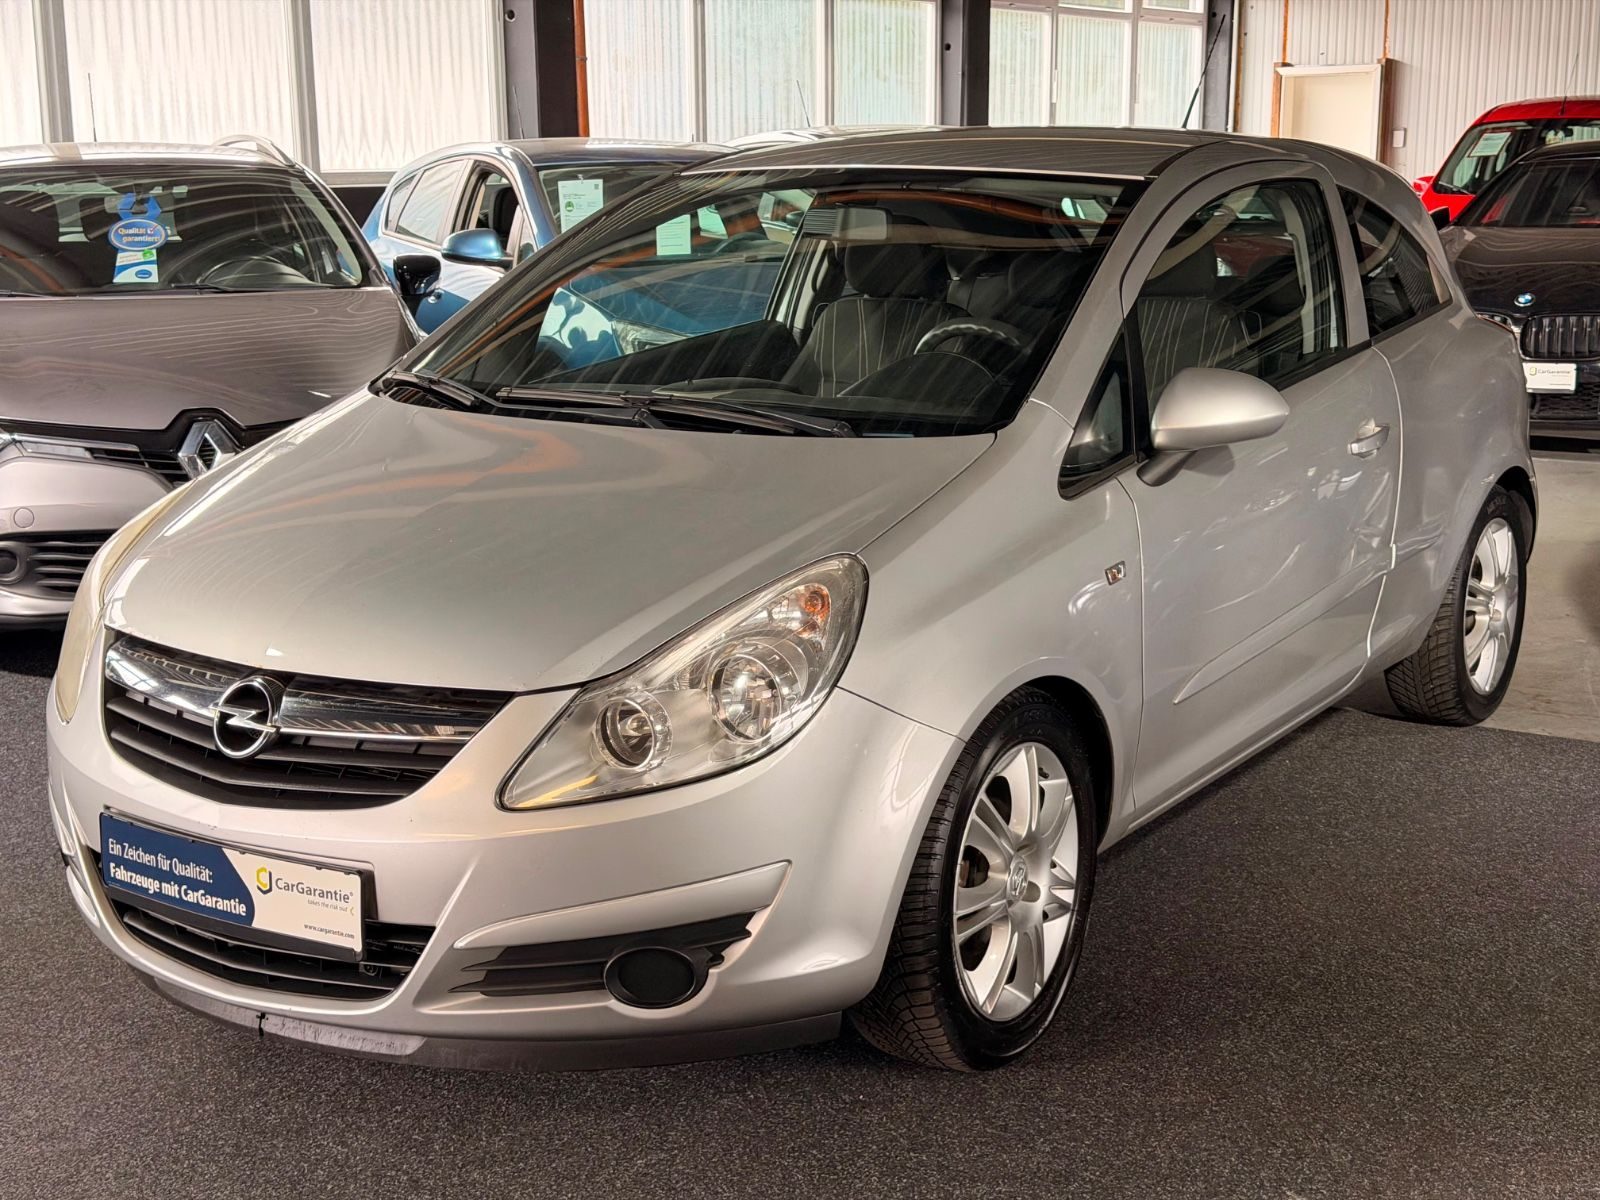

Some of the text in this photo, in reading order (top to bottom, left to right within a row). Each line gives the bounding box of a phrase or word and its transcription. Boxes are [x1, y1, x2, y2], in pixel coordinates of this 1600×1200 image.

[108, 838, 213, 884] Ein Zeichen für Qualität:
[109, 862, 247, 916] Fahrzeuge mit CarGarantie
[321, 901, 330, 909] the
[330, 902, 338, 910] risk
[304, 923, 355, 940] www.cargarantie.com
